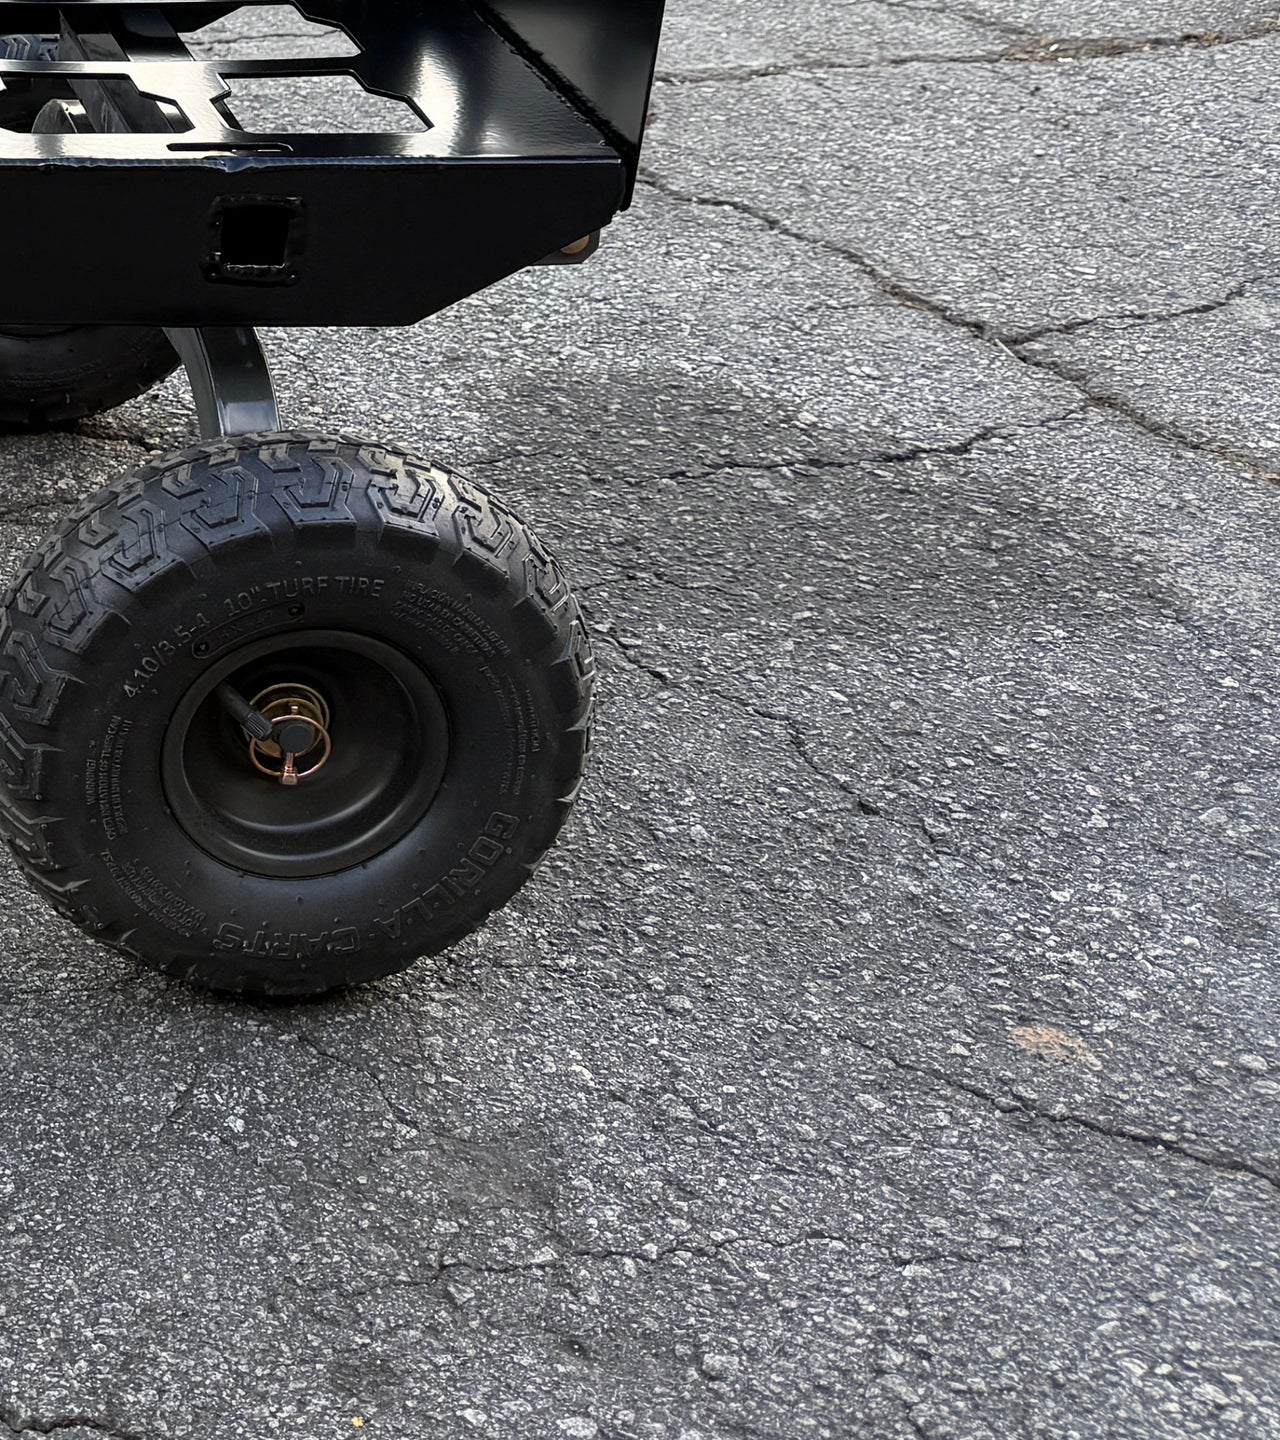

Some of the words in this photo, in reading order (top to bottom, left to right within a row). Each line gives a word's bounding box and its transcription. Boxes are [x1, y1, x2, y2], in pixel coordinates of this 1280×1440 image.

[122, 611, 211, 698] 4.10/3.5-4
[222, 586, 262, 616] 10"
[264, 577, 329, 600] TURF
[333, 576, 385, 597] TIRE
[374, 810, 520, 939] GORILLA
[210, 920, 362, 957] CARTS
